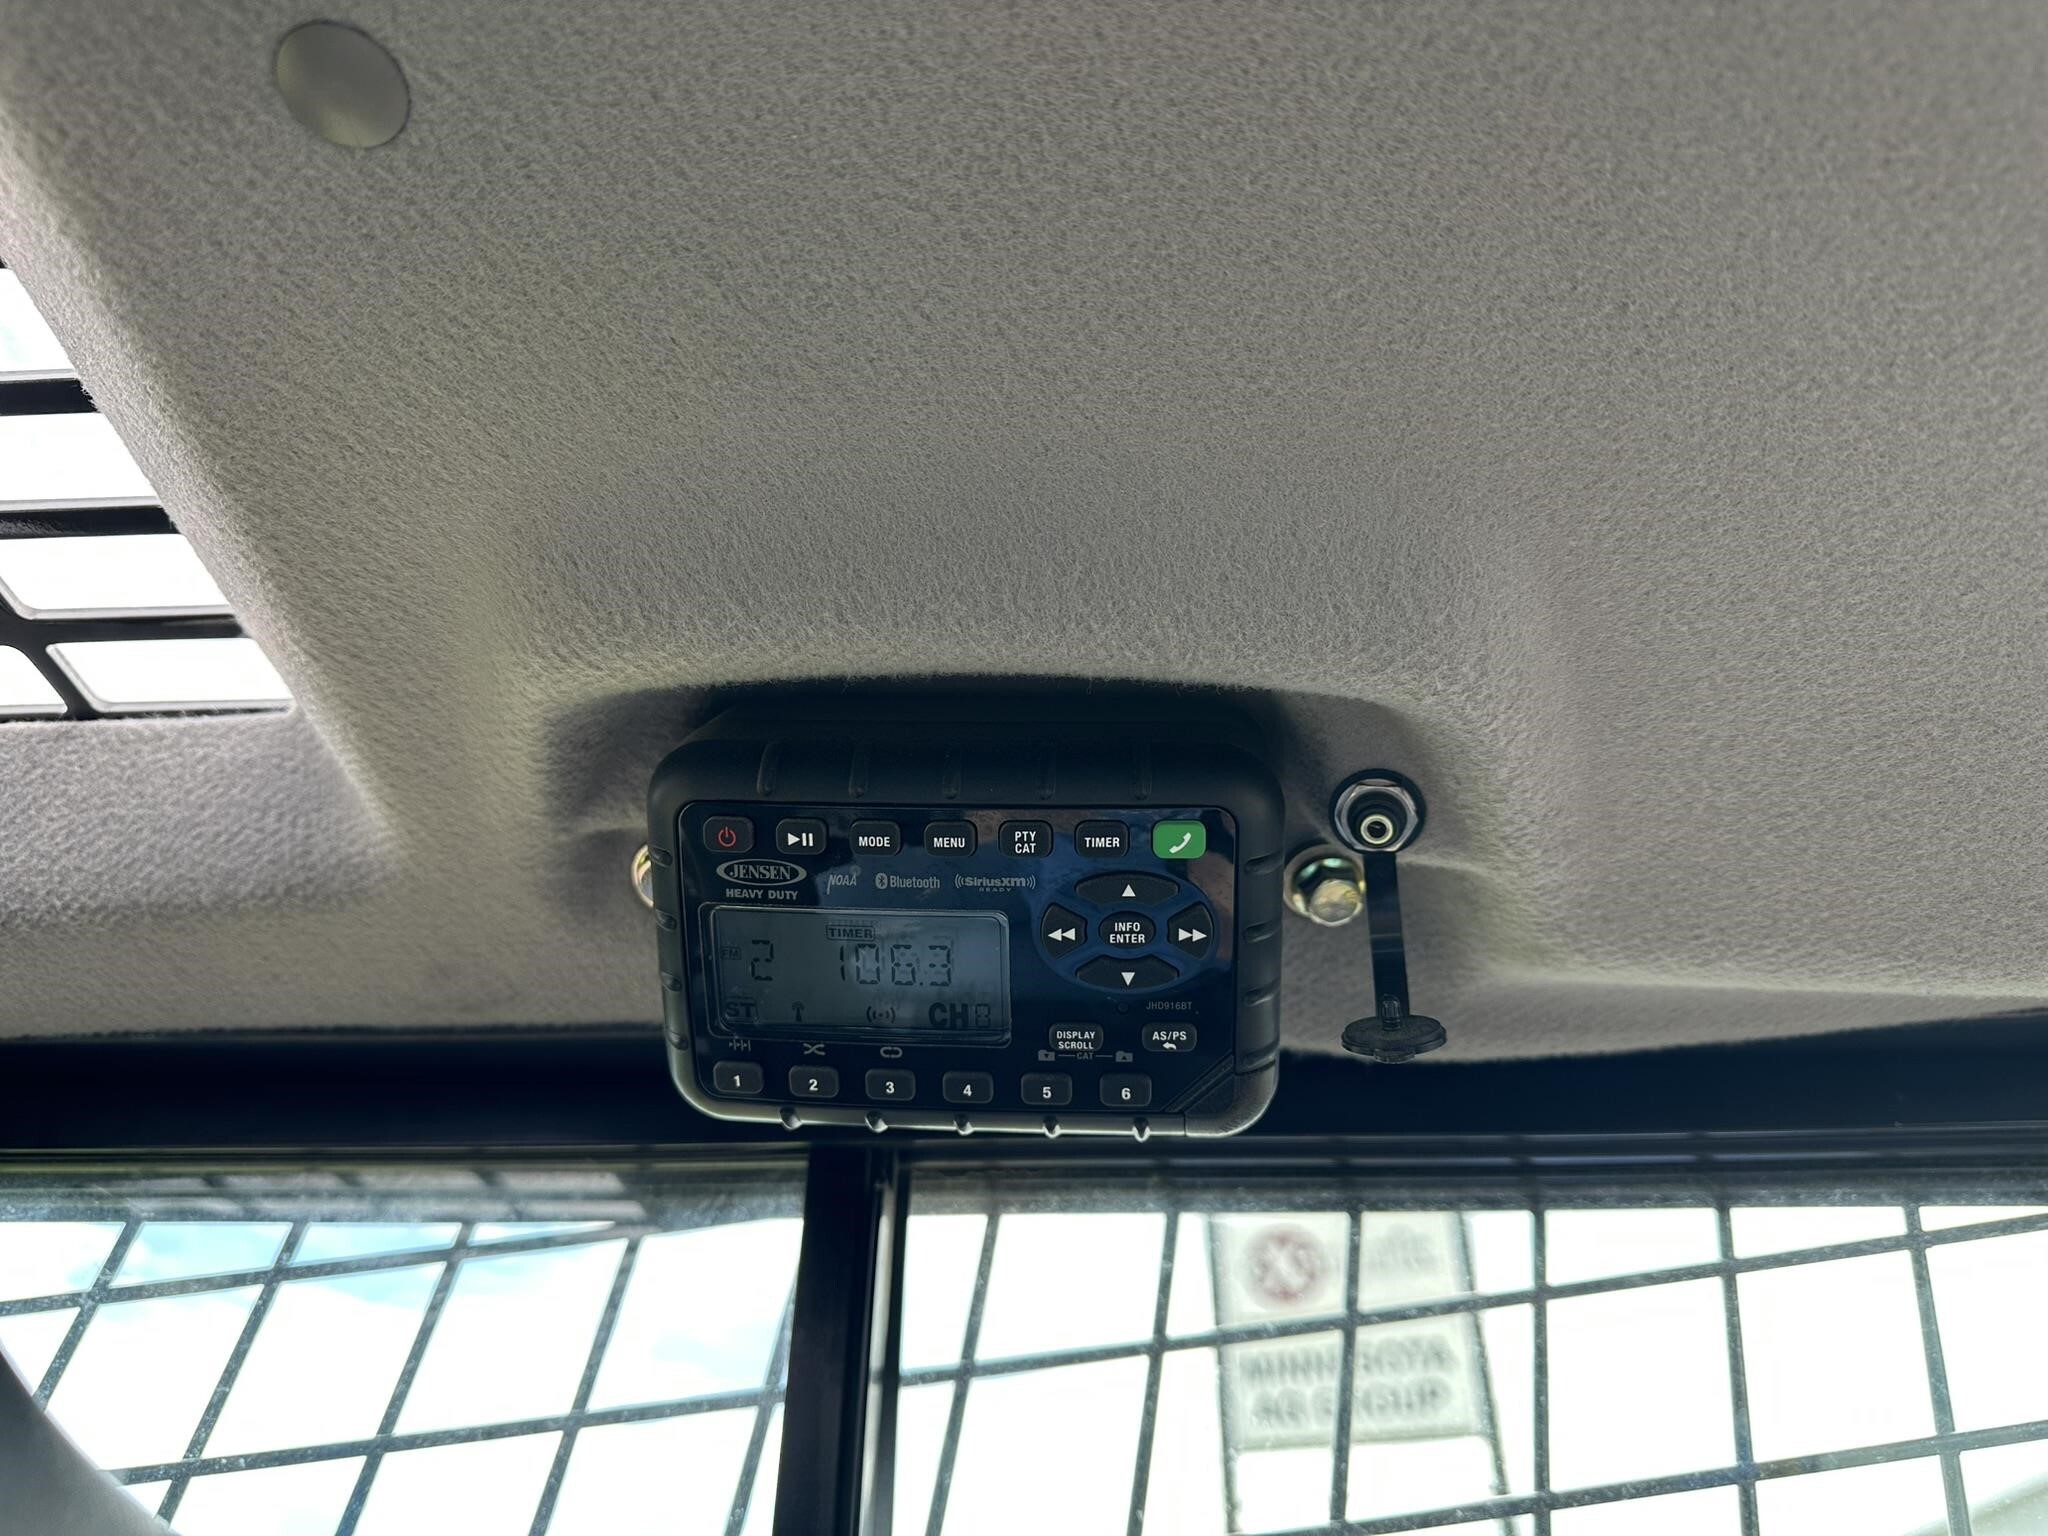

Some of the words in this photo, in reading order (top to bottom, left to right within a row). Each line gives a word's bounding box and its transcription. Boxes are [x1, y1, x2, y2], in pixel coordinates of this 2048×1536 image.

[858, 836, 891, 848] MODE
[933, 836, 966, 848] MENU
[1014, 830, 1037, 842] PTY
[1084, 836, 1121, 848] TIMER
[1014, 843, 1037, 855] CAT
[729, 865, 791, 880] JENSEN
[827, 872, 857, 895] NOAA
[890, 875, 941, 889] Bluetooth
[726, 888, 764, 899] HEAVY
[768, 890, 799, 900] DUTY
[1114, 922, 1141, 932] INFO
[828, 928, 873, 939] TIMER
[1109, 933, 1146, 944] ENTER
[751, 939, 776, 981] 2
[839, 943, 952, 987] 106.3
[726, 1001, 756, 1018] ST
[1146, 1001, 1193, 1010] JHD916BT
[1056, 1031, 1096, 1040] DISPLAY
[1152, 1031, 1188, 1041] AS/PS
[1057, 1040, 1094, 1050] SCROLL
[1076, 1052, 1094, 1060] CAT
[731, 1075, 742, 1088] 1
[808, 1078, 819, 1091] 2
[885, 1081, 895, 1094] 3
[962, 1084, 973, 1097] 4
[1042, 1086, 1052, 1100] 5
[1121, 1087, 1131, 1100] 6
